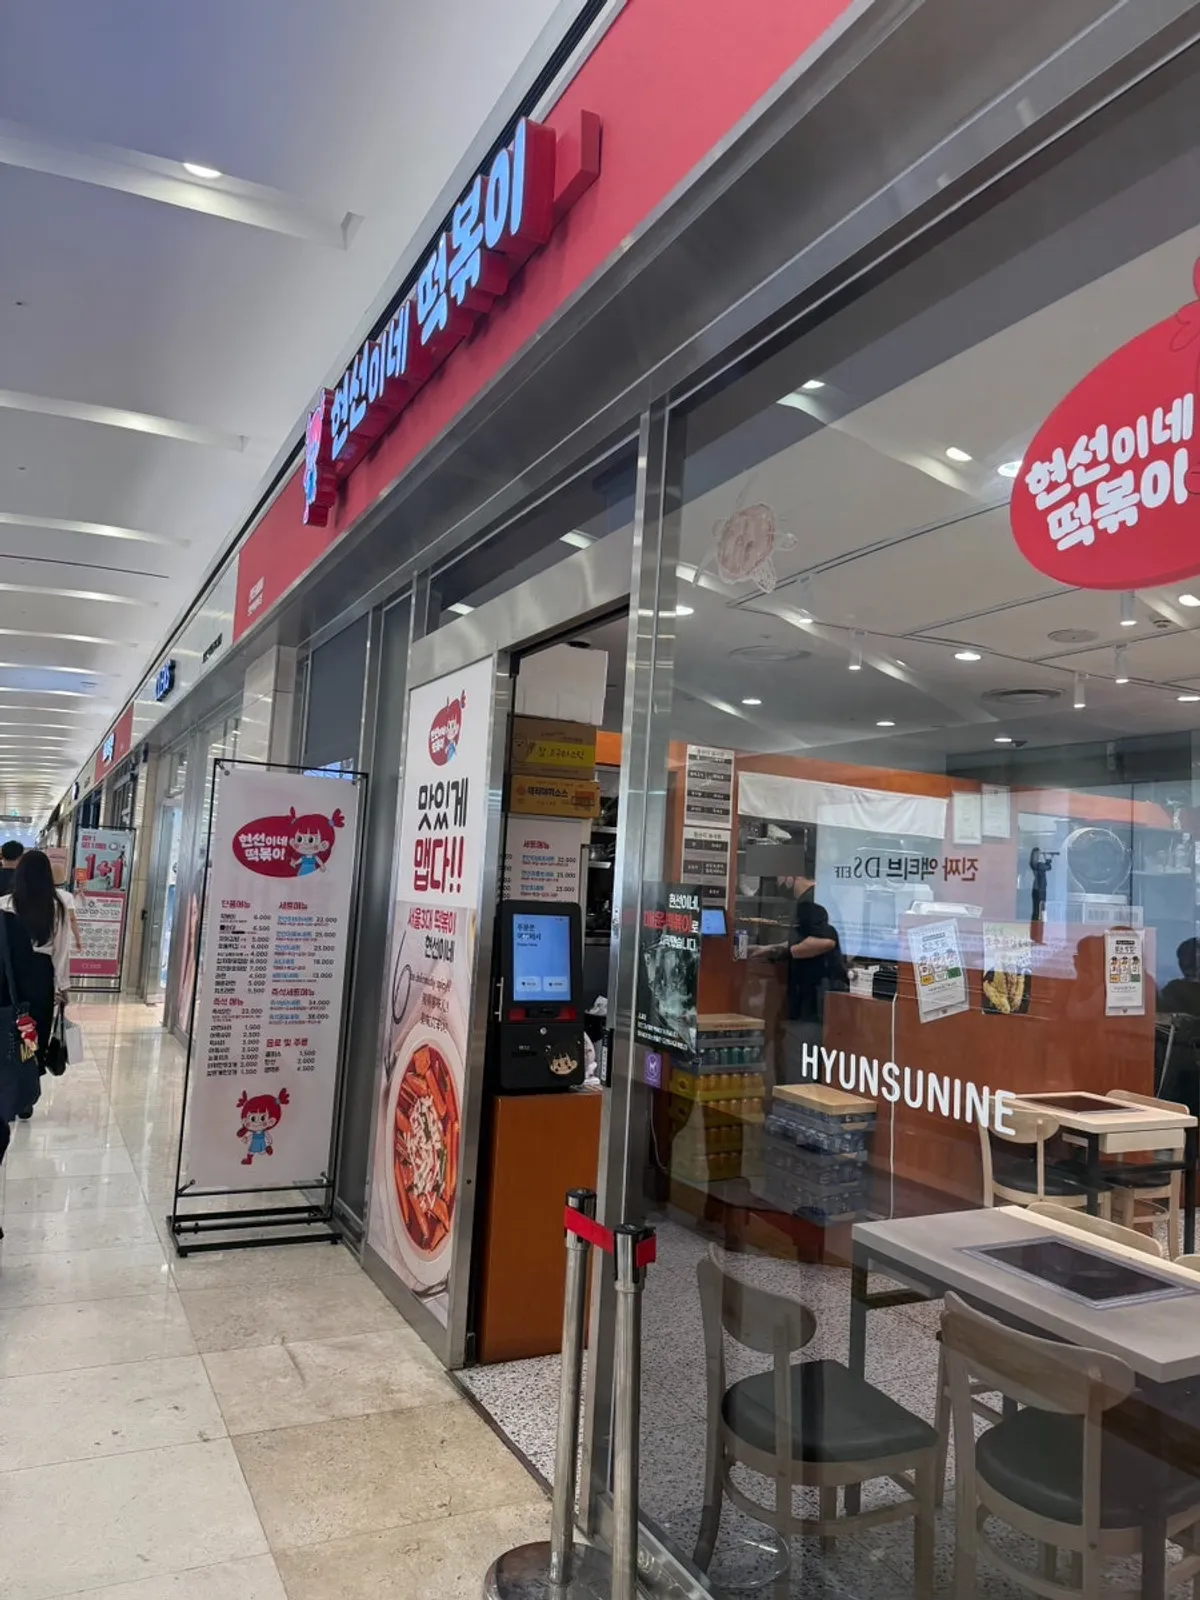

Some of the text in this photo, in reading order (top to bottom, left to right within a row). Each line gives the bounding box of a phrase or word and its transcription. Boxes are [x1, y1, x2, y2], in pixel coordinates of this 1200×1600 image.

[331, 116, 527, 461] 현선이네 떡볶이
[1025, 392, 1195, 511] 현선이네
[1046, 447, 1189, 552] 떡볶이
[417, 777, 470, 832] 맛있게
[238, 832, 289, 848] 현선이네
[244, 847, 286, 862] 떡볶이
[413, 835, 465, 895] 맵다!!
[425, 934, 455, 962] 현선이네
[802, 1042, 1017, 1137] HYUNSUNINE
